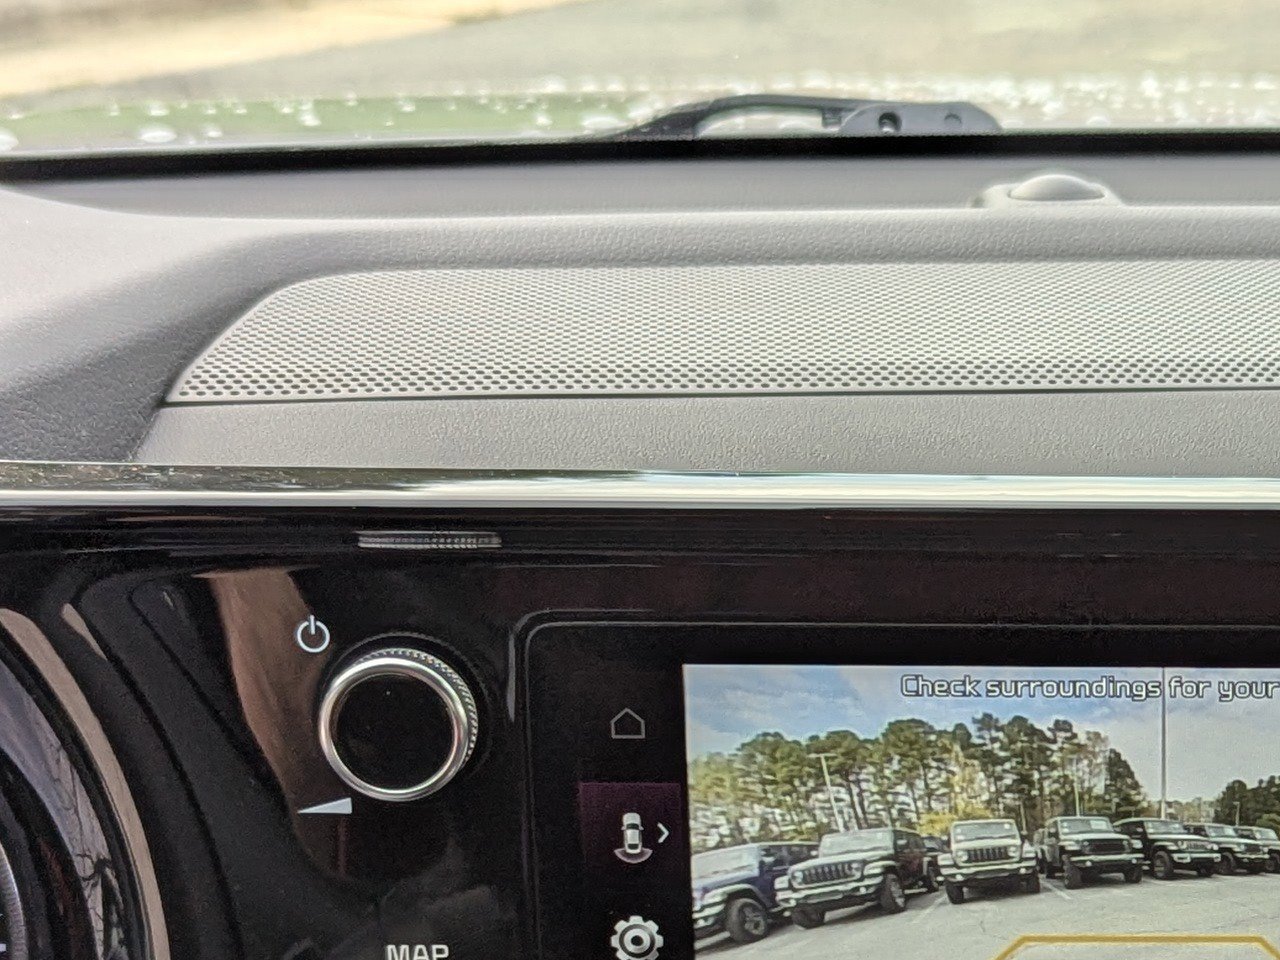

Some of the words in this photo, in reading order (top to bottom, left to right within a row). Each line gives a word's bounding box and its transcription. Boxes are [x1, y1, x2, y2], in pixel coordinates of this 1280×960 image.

[900, 674, 982, 698] Check
[985, 675, 1162, 702] surroundings
[1168, 676, 1212, 699] for
[1217, 680, 1280, 702] your
